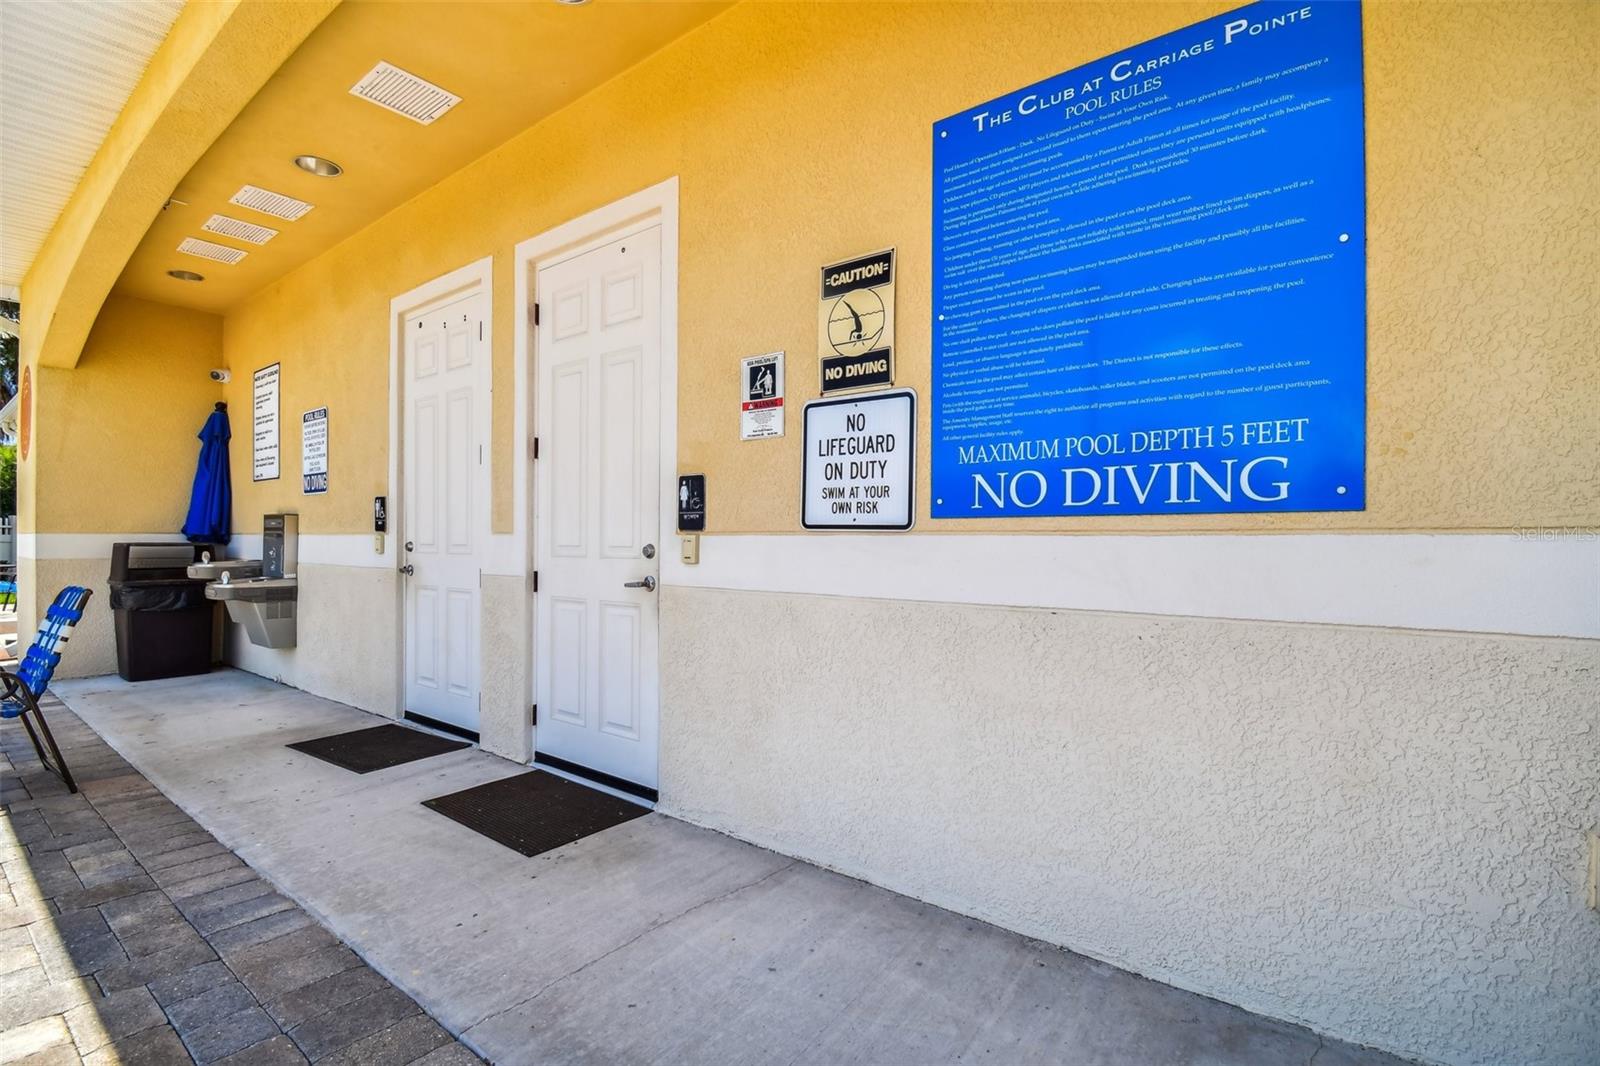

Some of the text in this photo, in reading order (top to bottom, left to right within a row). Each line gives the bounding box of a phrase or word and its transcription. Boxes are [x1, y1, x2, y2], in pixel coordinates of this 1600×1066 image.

[972, 6, 1310, 131] THE CLUB AT CARRIAGE POINTE
[1264, 71, 1280, 80] may
[1281, 58, 1323, 75] accompany
[1065, 76, 1161, 119] POOL RULES
[1252, 99, 1268, 111] pool
[1268, 107, 1284, 118] with
[1282, 181, 1298, 190] well
[1251, 225, 1260, 233] all
[1261, 223, 1273, 231] the
[1269, 262, 1286, 271] your
[1288, 253, 1334, 265] convenience
[830, 262, 883, 287] CAUTION
[825, 359, 887, 381] NO DIVING
[1257, 362, 1273, 372] pool
[1275, 360, 1292, 368] deck
[1263, 382, 1283, 391] guest
[847, 414, 865, 432] NO
[818, 434, 895, 457] LIFEGUARD
[959, 418, 1308, 463] MAXIMUM POOL DEPTH 5 FEET
[825, 460, 886, 480] ON DUTY
[971, 456, 1289, 508] NO DIVING
[822, 485, 890, 500] SWIM AT YOUR
[831, 500, 879, 515] OWN RISK
